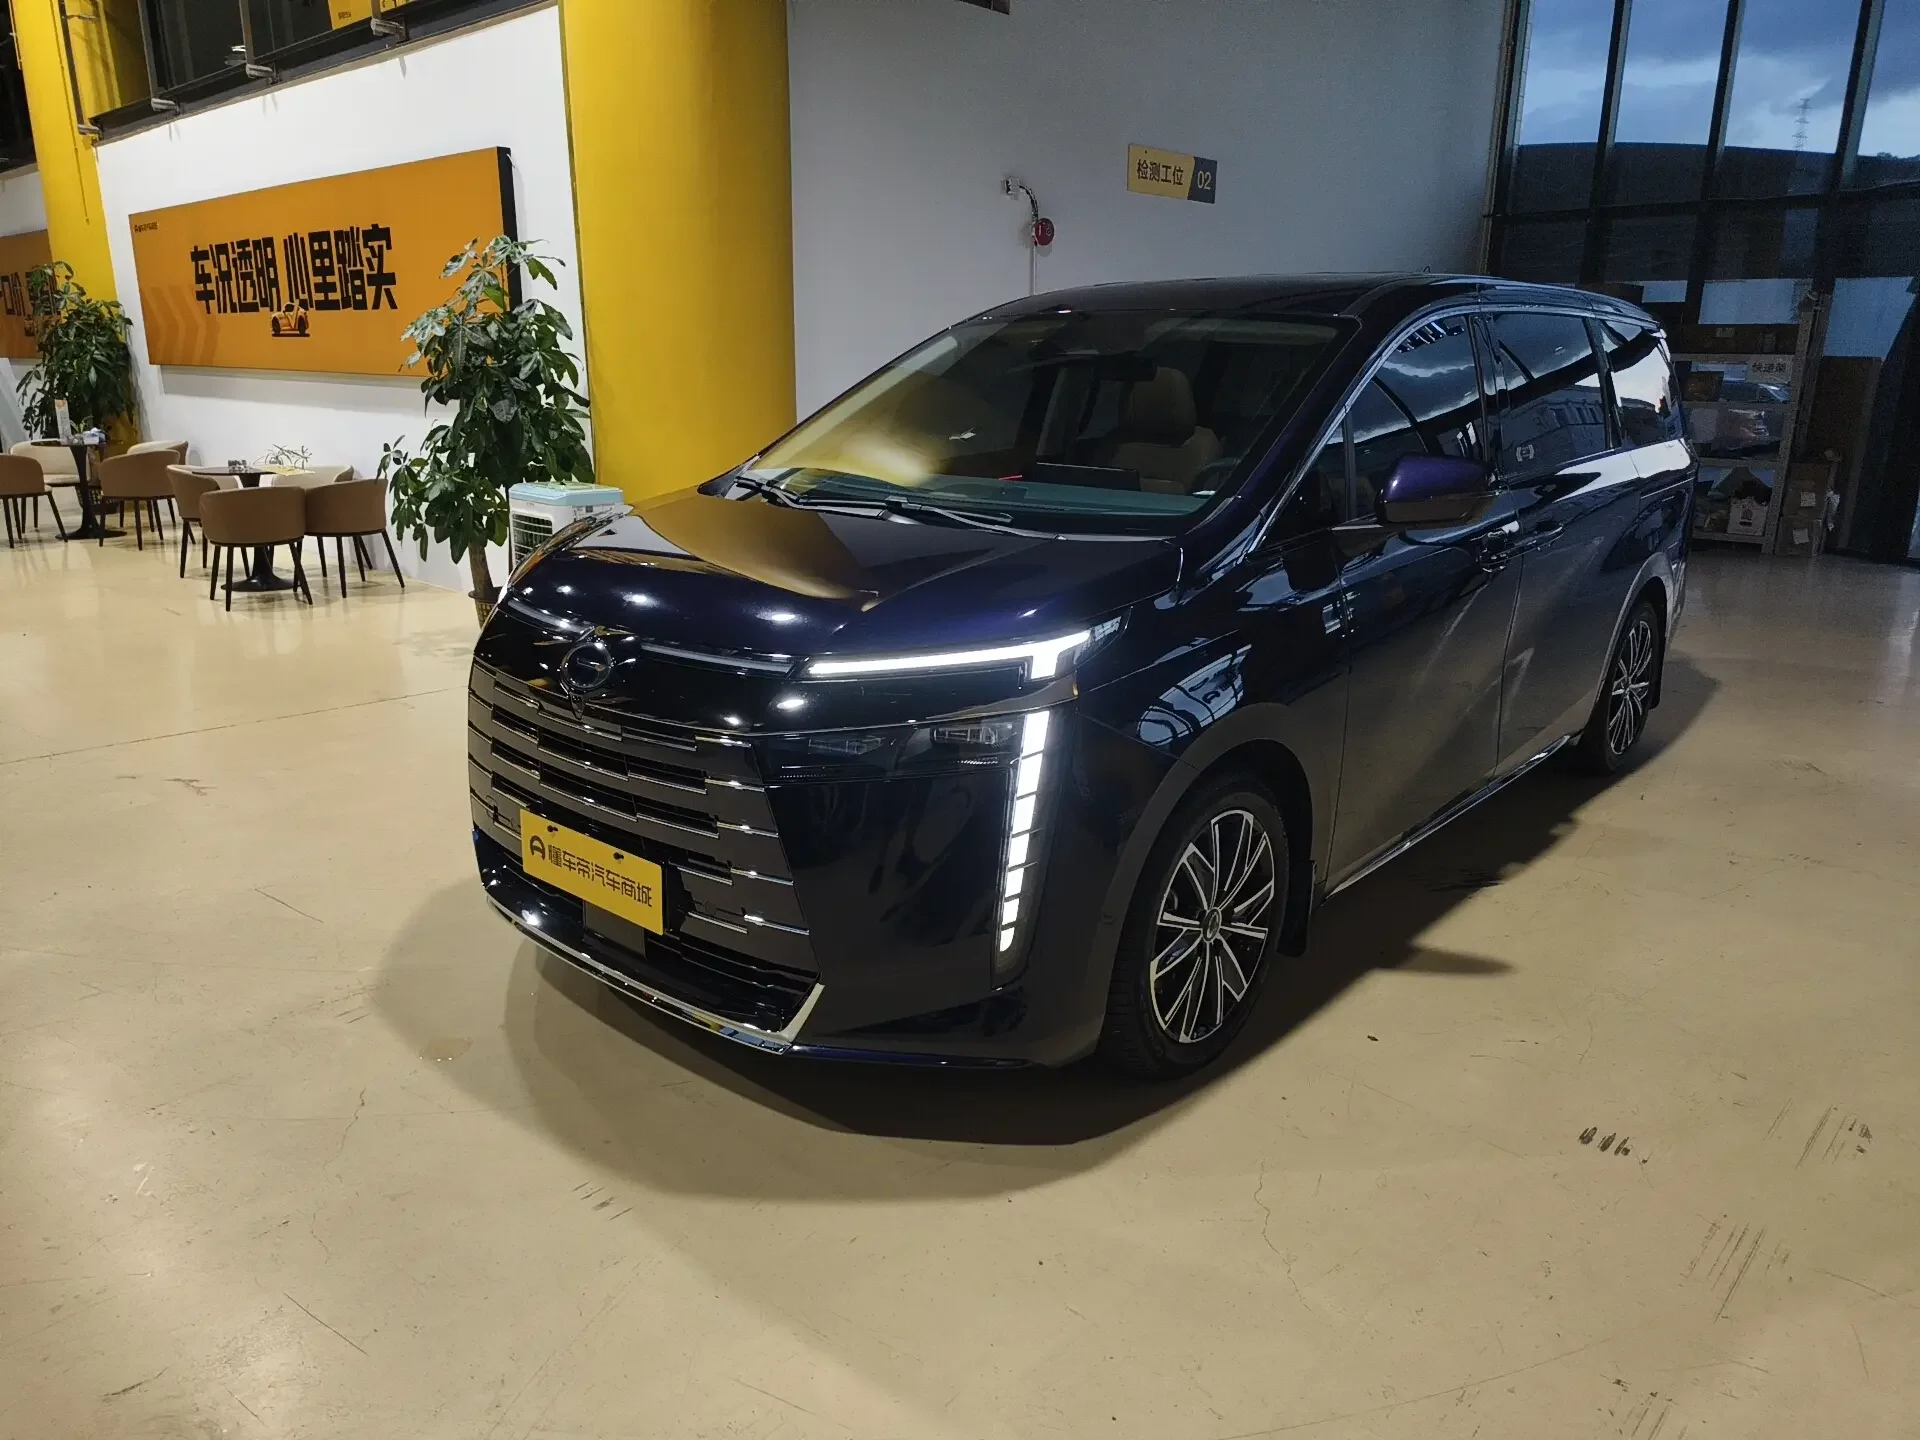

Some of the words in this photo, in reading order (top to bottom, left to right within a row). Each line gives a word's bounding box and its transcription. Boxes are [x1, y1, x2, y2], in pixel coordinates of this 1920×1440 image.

[1137, 159, 1184, 186] 检测工位
[1197, 171, 1212, 190] 02
[190, 237, 282, 315] 车况透明
[283, 223, 398, 311] 心里踏实
[547, 844, 653, 908] 懂车帝汽车商城
